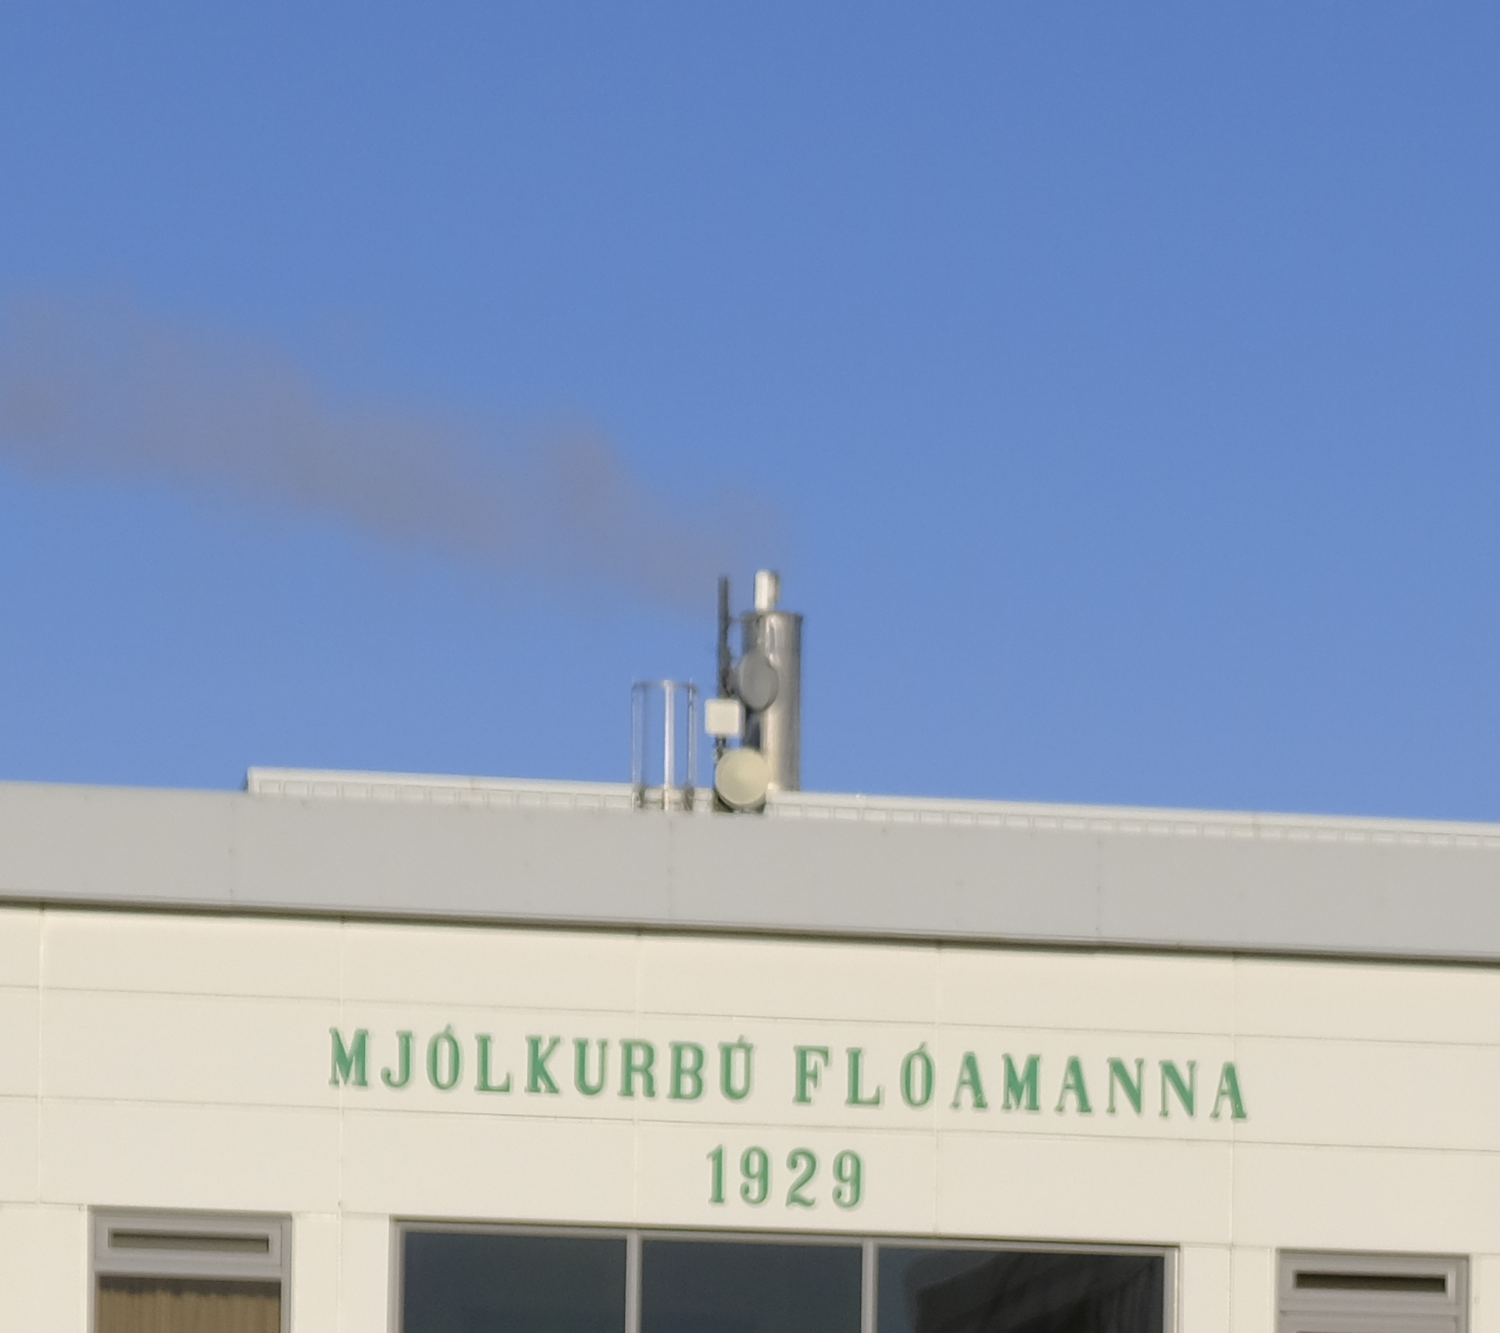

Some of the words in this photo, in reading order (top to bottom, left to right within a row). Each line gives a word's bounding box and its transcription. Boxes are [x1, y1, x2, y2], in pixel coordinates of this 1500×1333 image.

[328, 1026, 754, 1102] MJÓLKURBÚ
[791, 1043, 1248, 1121] FLÓAMANNA
[706, 1144, 865, 1209] 1929
